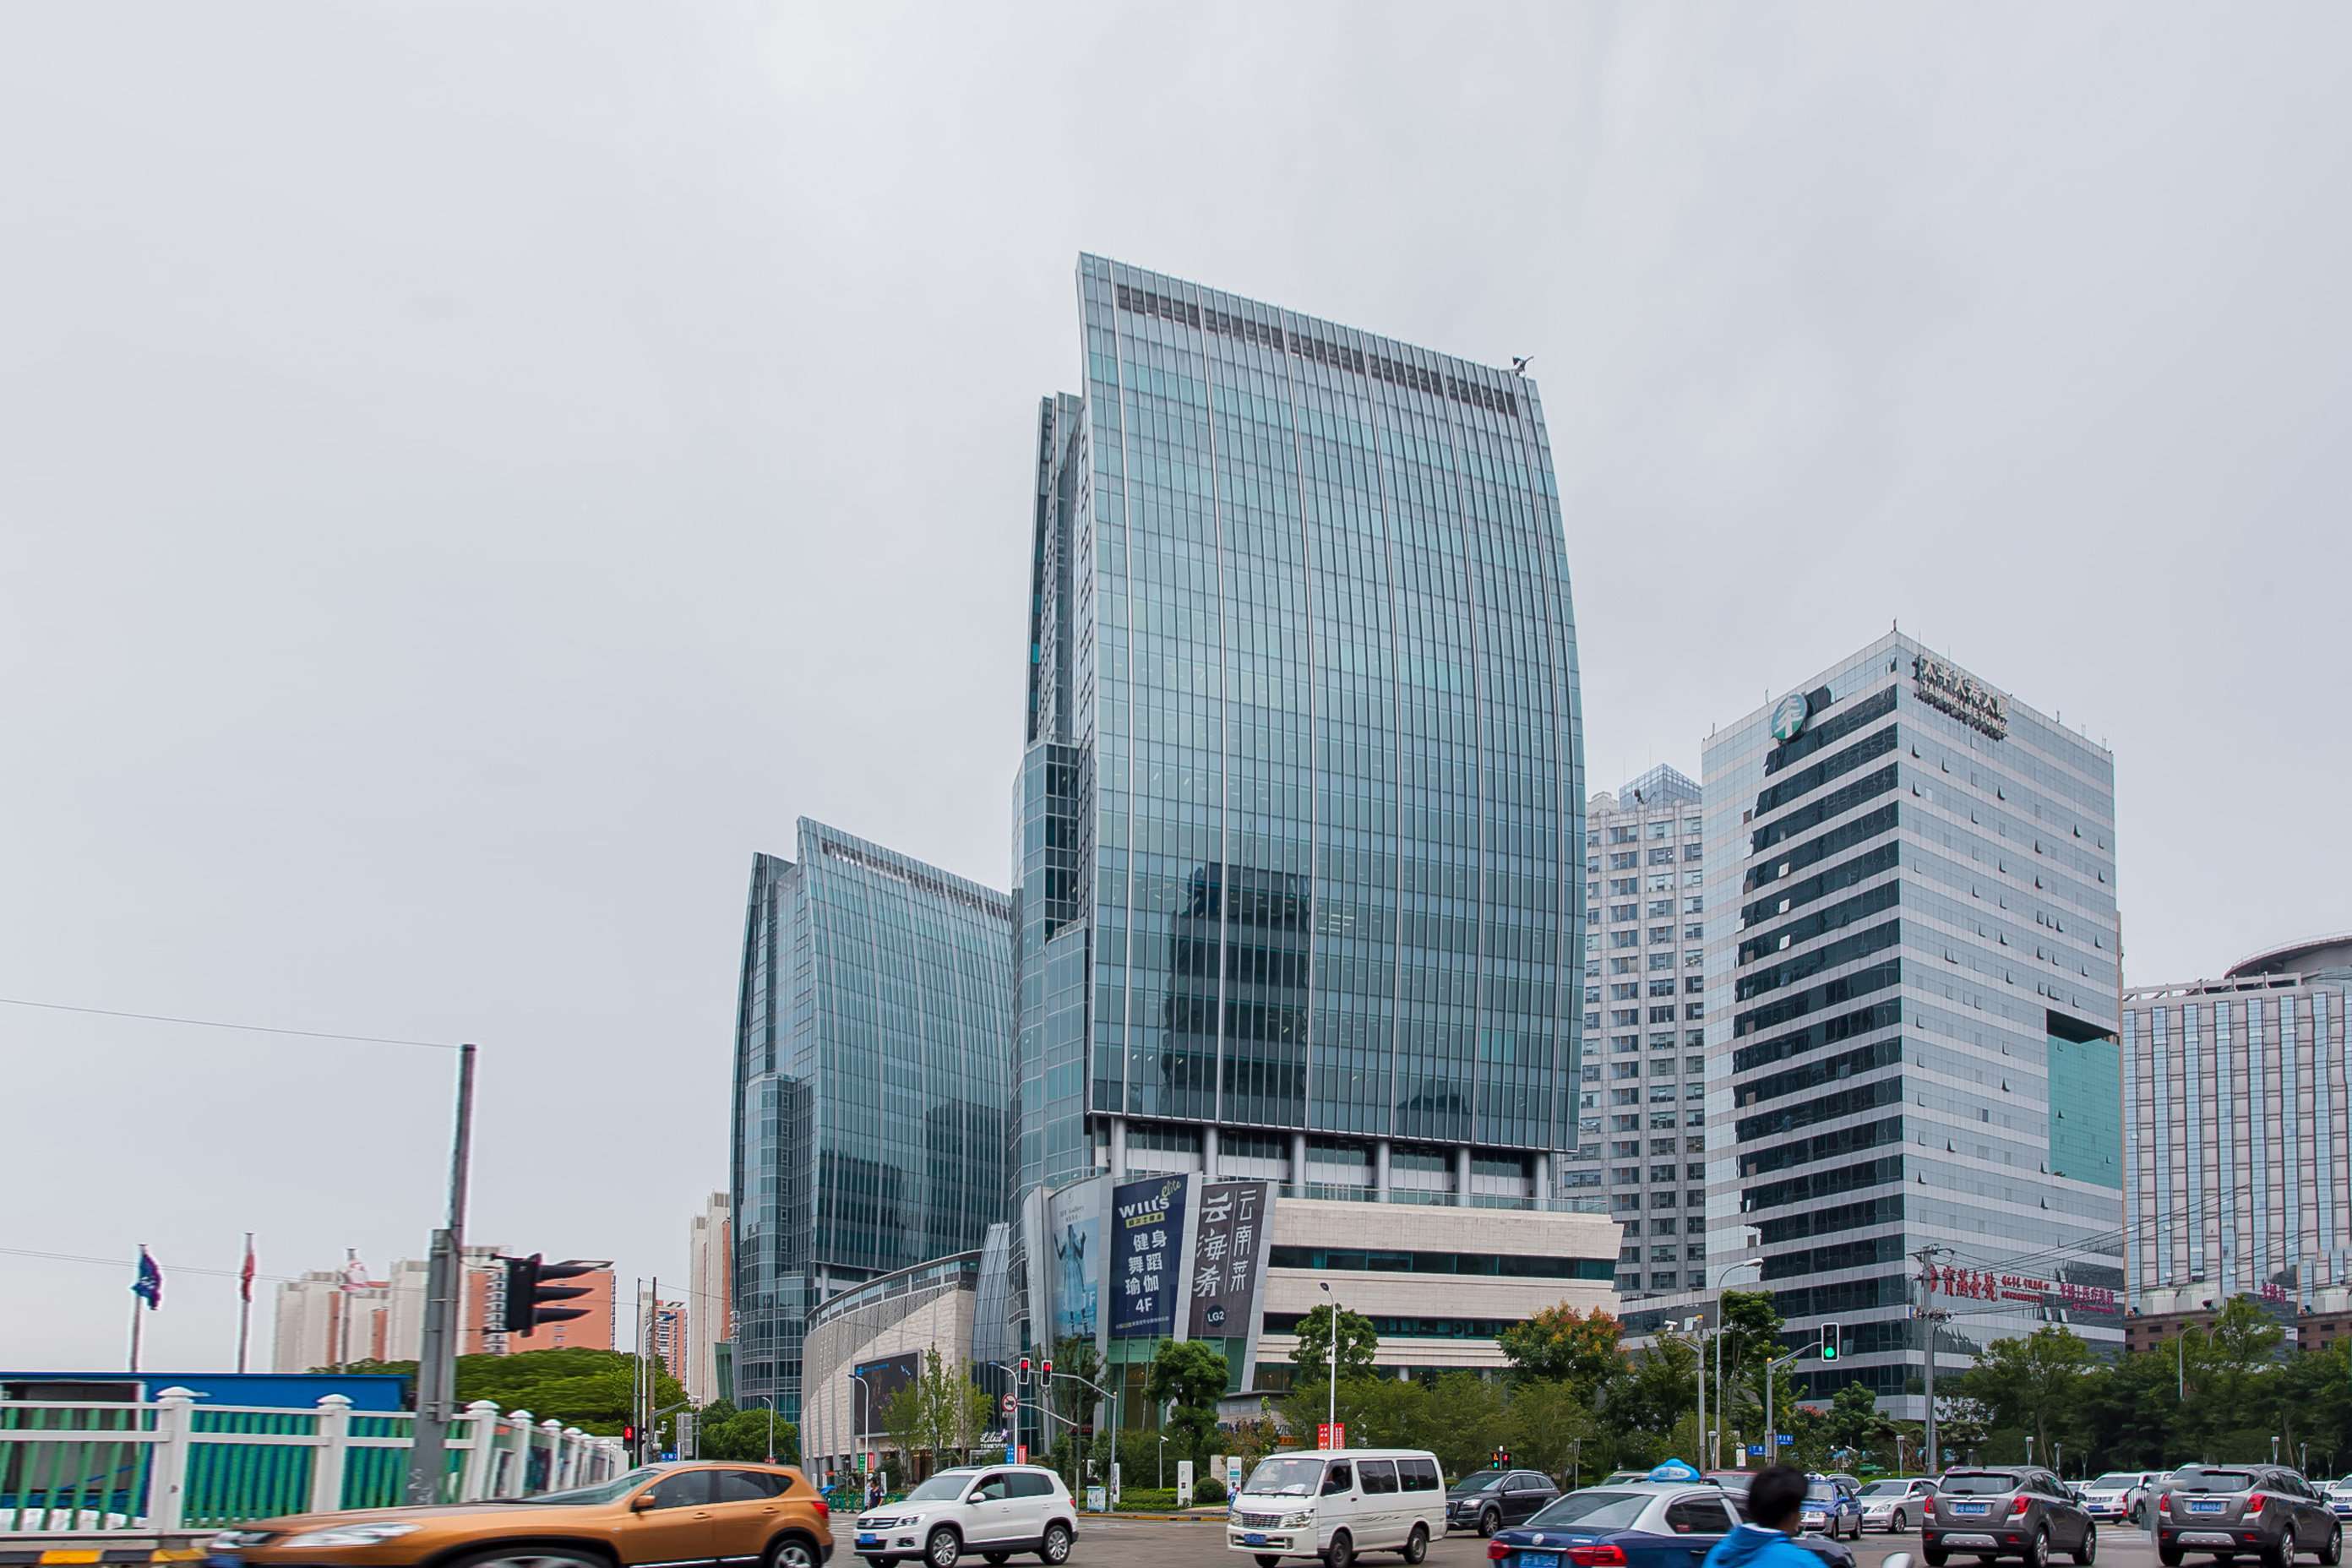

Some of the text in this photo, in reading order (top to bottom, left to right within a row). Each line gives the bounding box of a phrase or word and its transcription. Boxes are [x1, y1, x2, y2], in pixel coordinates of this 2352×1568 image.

[1133, 1230, 1168, 1252] 健身
[1193, 1192, 1233, 1298] 云海肴
[1230, 1190, 1257, 1292] 云南菜
[1128, 1252, 1162, 1274] 舞蹈
[1124, 1275, 1160, 1296] 瑜伽
[1135, 1298, 1153, 1313] 4F
[1207, 1310, 1225, 1321] LG2
